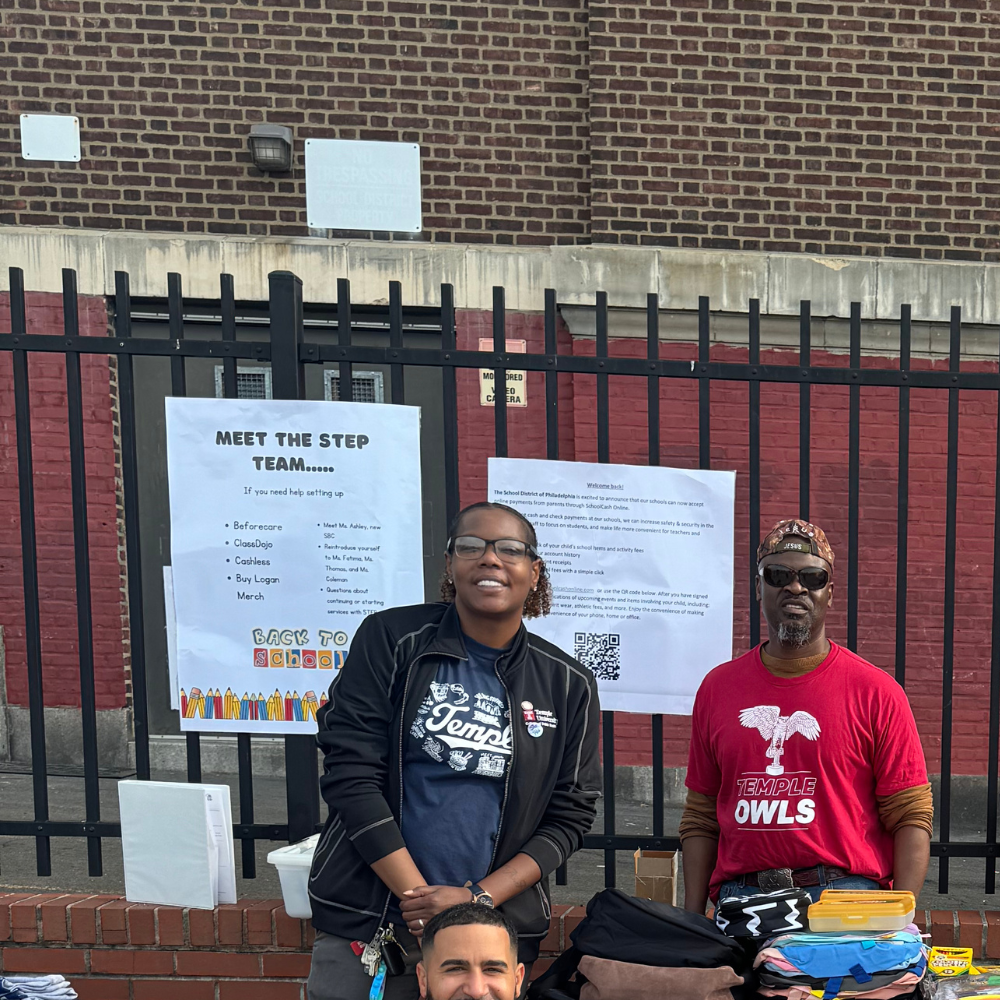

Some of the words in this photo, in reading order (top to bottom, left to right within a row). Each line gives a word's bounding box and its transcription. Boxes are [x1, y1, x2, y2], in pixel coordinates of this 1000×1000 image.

[483, 373, 522, 381] MOORED
[486, 395, 521, 403] CAERA
[216, 431, 267, 446] MEET
[275, 432, 312, 447] THE
[319, 433, 369, 450] STEP
[252, 456, 335, 472] TEAM.....
[244, 487, 252, 495] If
[254, 489, 268, 497] you
[270, 488, 287, 496] need
[289, 488, 305, 498] help
[306, 489, 333, 498] setting
[233, 521, 282, 531] Beforecare
[234, 538, 273, 550] ClassDojo
[235, 556, 271, 566] Cashless
[236, 573, 252, 585] Buy
[254, 574, 280, 585] Logan
[237, 591, 264, 601] Merch
[252, 628, 309, 646] BACK
[319, 630, 348, 647] TO
[425, 702, 512, 749] Templ
[736, 777, 817, 797] TEMPLE
[734, 798, 816, 826] OWLS
